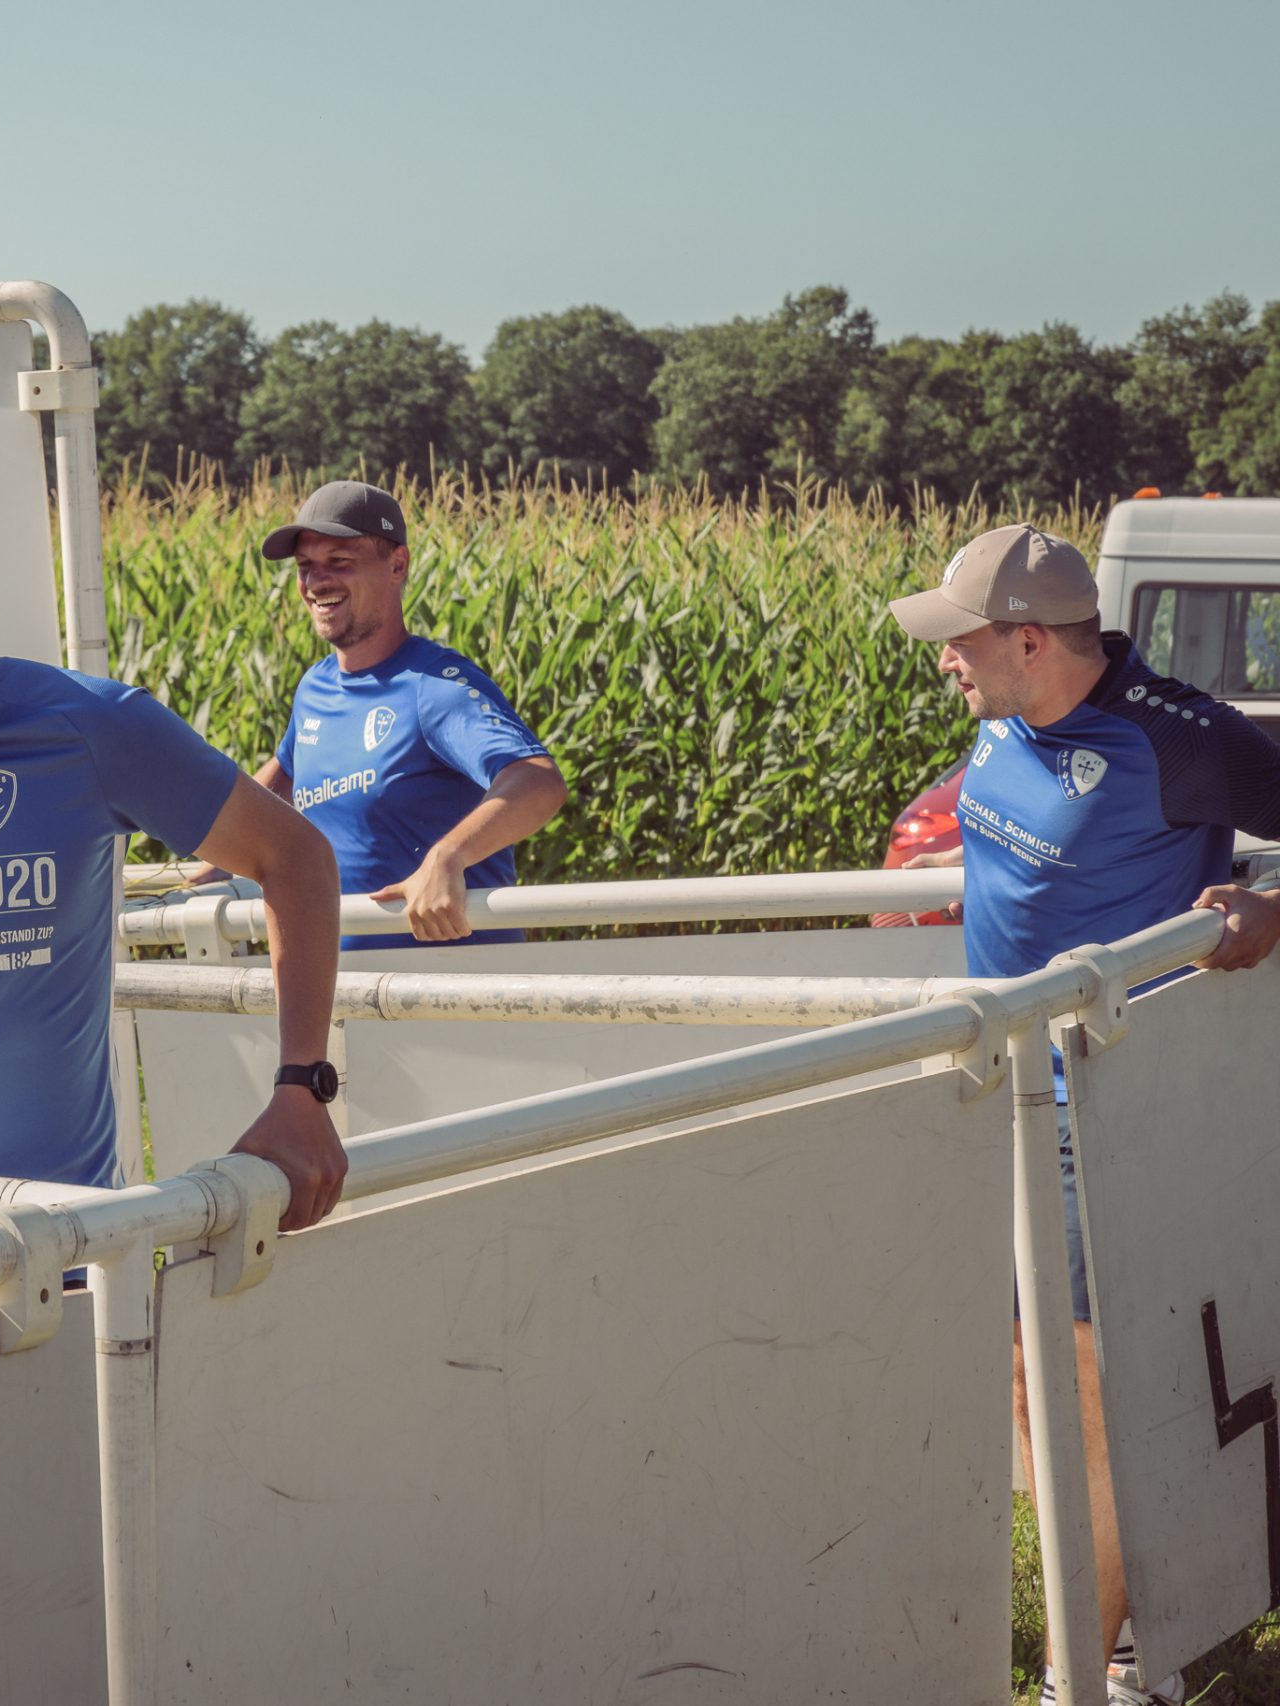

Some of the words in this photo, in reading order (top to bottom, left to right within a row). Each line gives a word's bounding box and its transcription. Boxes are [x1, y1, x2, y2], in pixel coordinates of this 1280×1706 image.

[973, 739, 993, 767] LB
[960, 789, 1001, 826] MICHAEL
[1004, 819, 1062, 858] SCHMICH
[964, 816, 979, 831] AIR
[979, 825, 1009, 849] SUPPLY
[1010, 842, 1041, 868] MEDIEN
[37, 926, 55, 940] ZU?
[6, 951, 32, 970] 182
